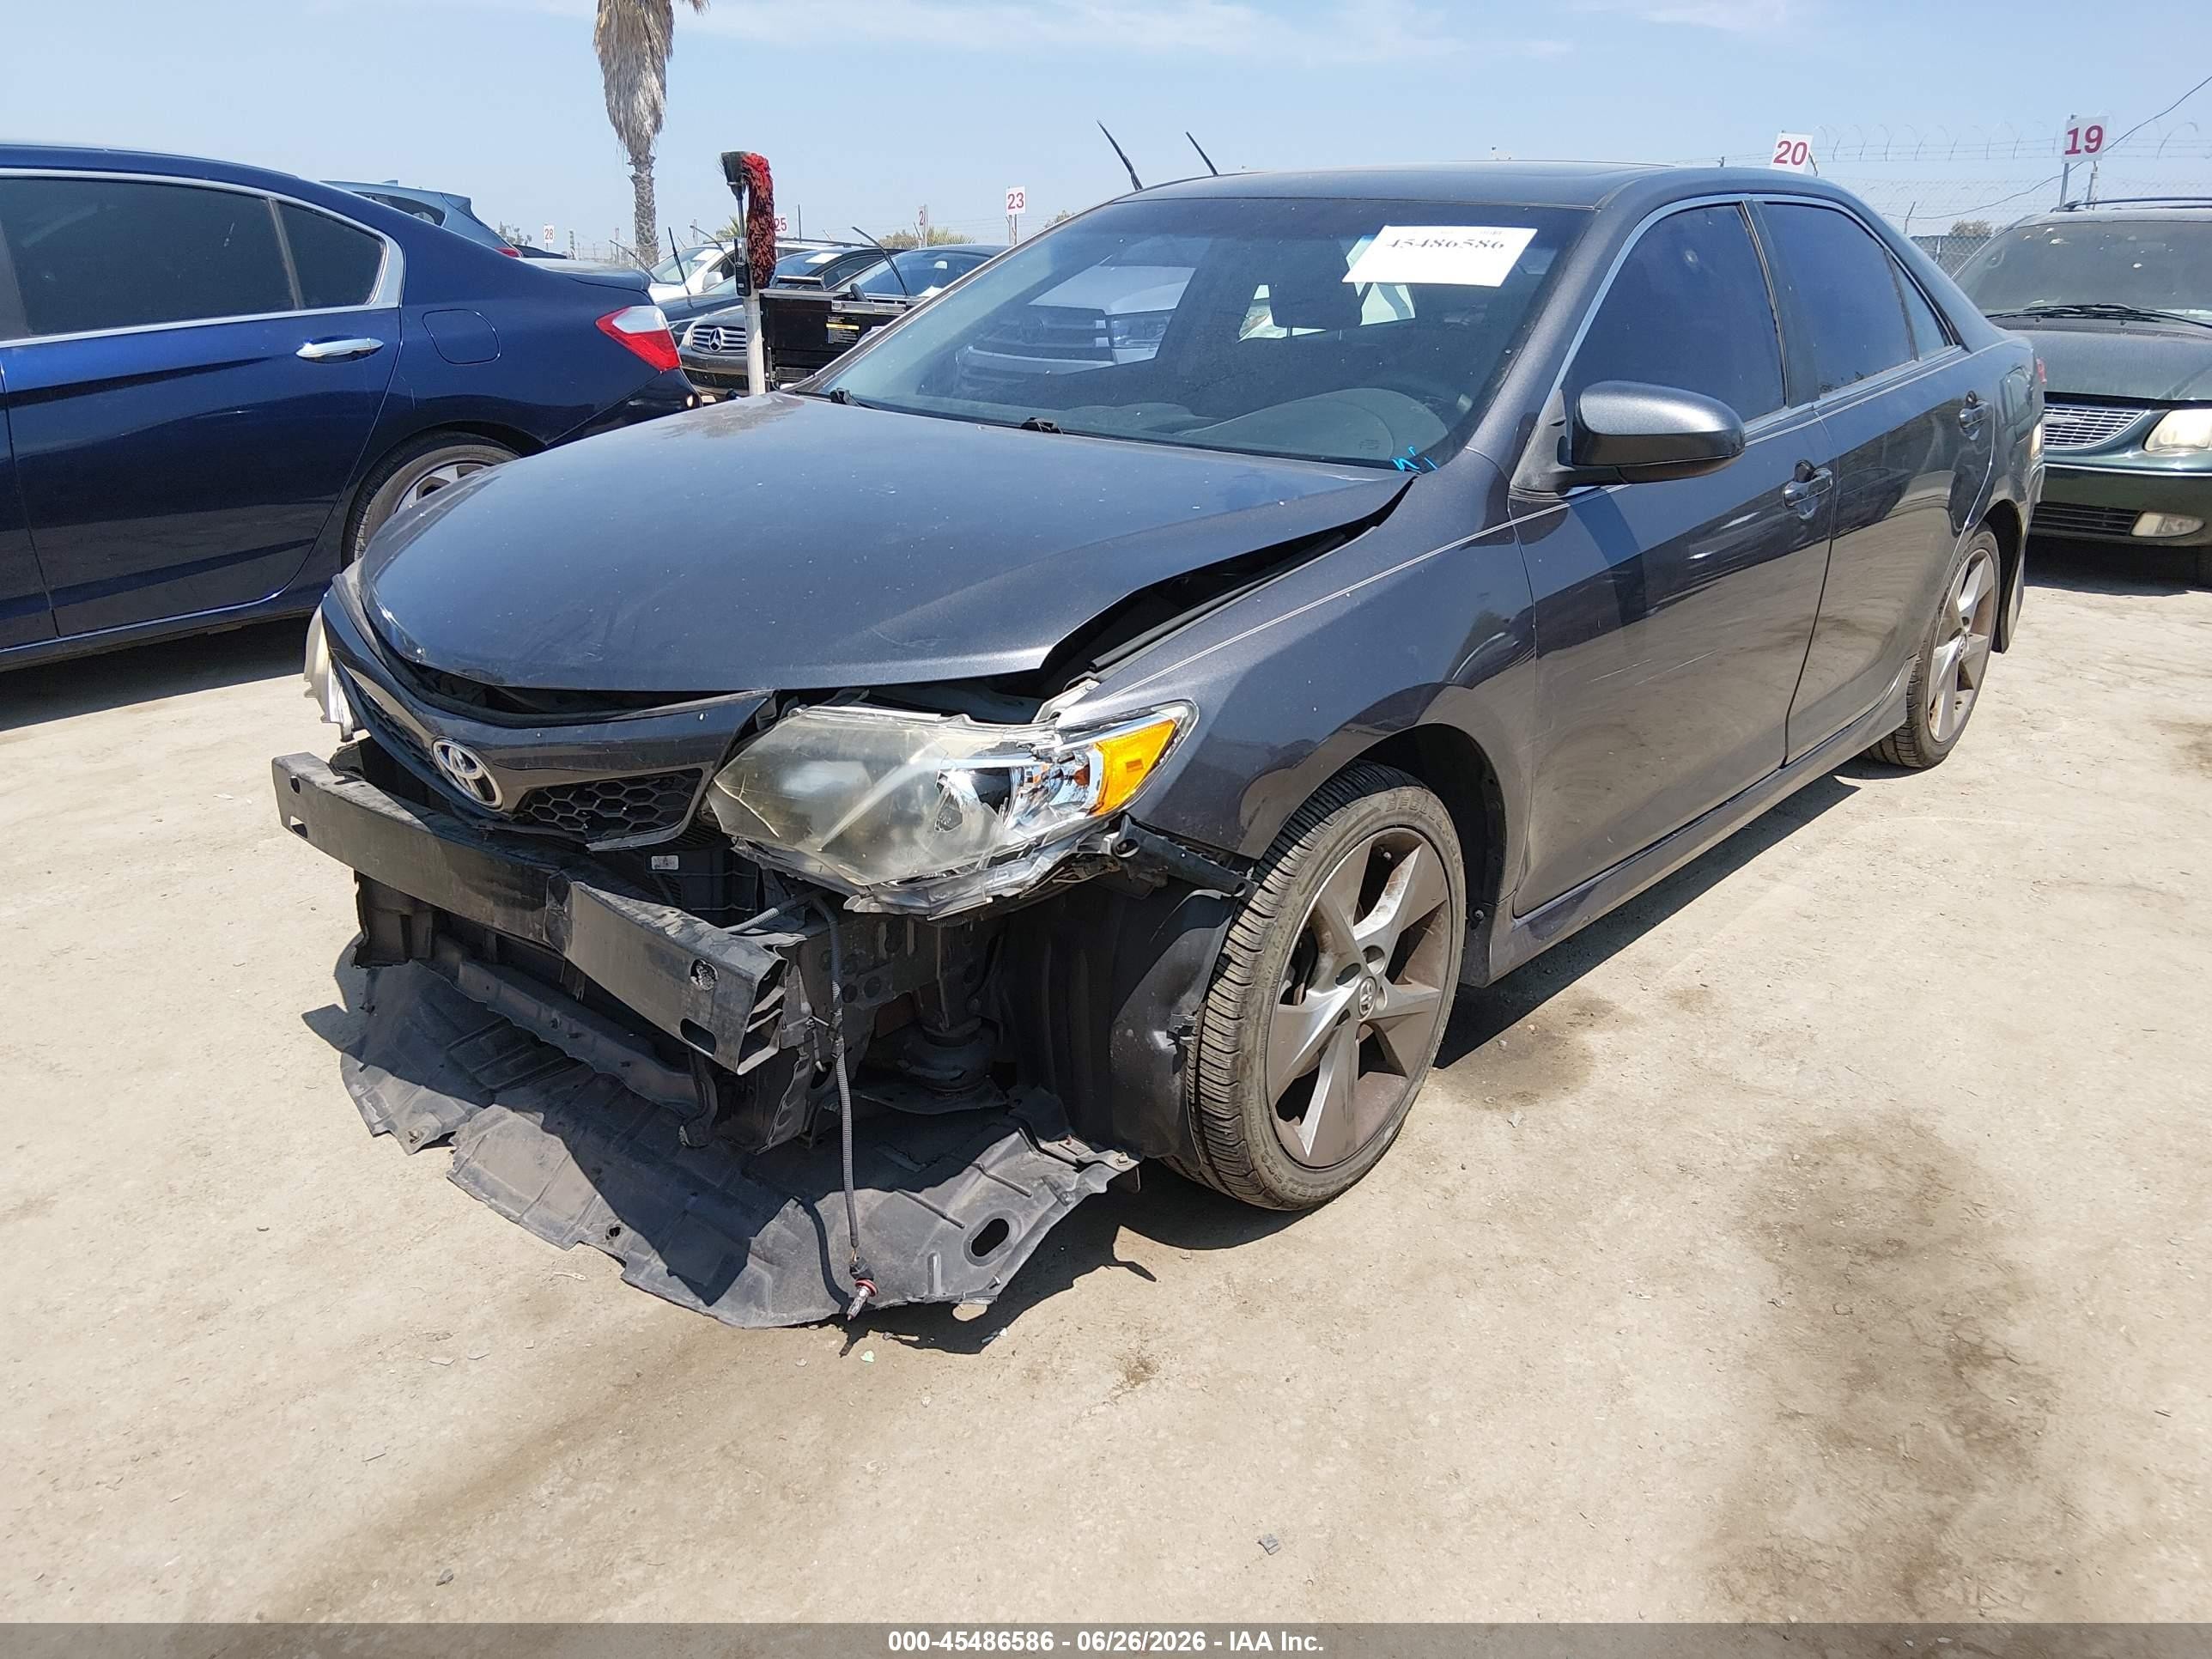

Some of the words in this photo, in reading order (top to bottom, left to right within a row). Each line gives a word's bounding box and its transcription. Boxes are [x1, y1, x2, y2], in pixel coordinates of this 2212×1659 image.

[2065, 125, 2103, 155] 19
[1773, 141, 1808, 165] 20
[1008, 192, 1024, 210] 23
[774, 217, 787, 232] 25
[544, 228, 554, 240] 28
